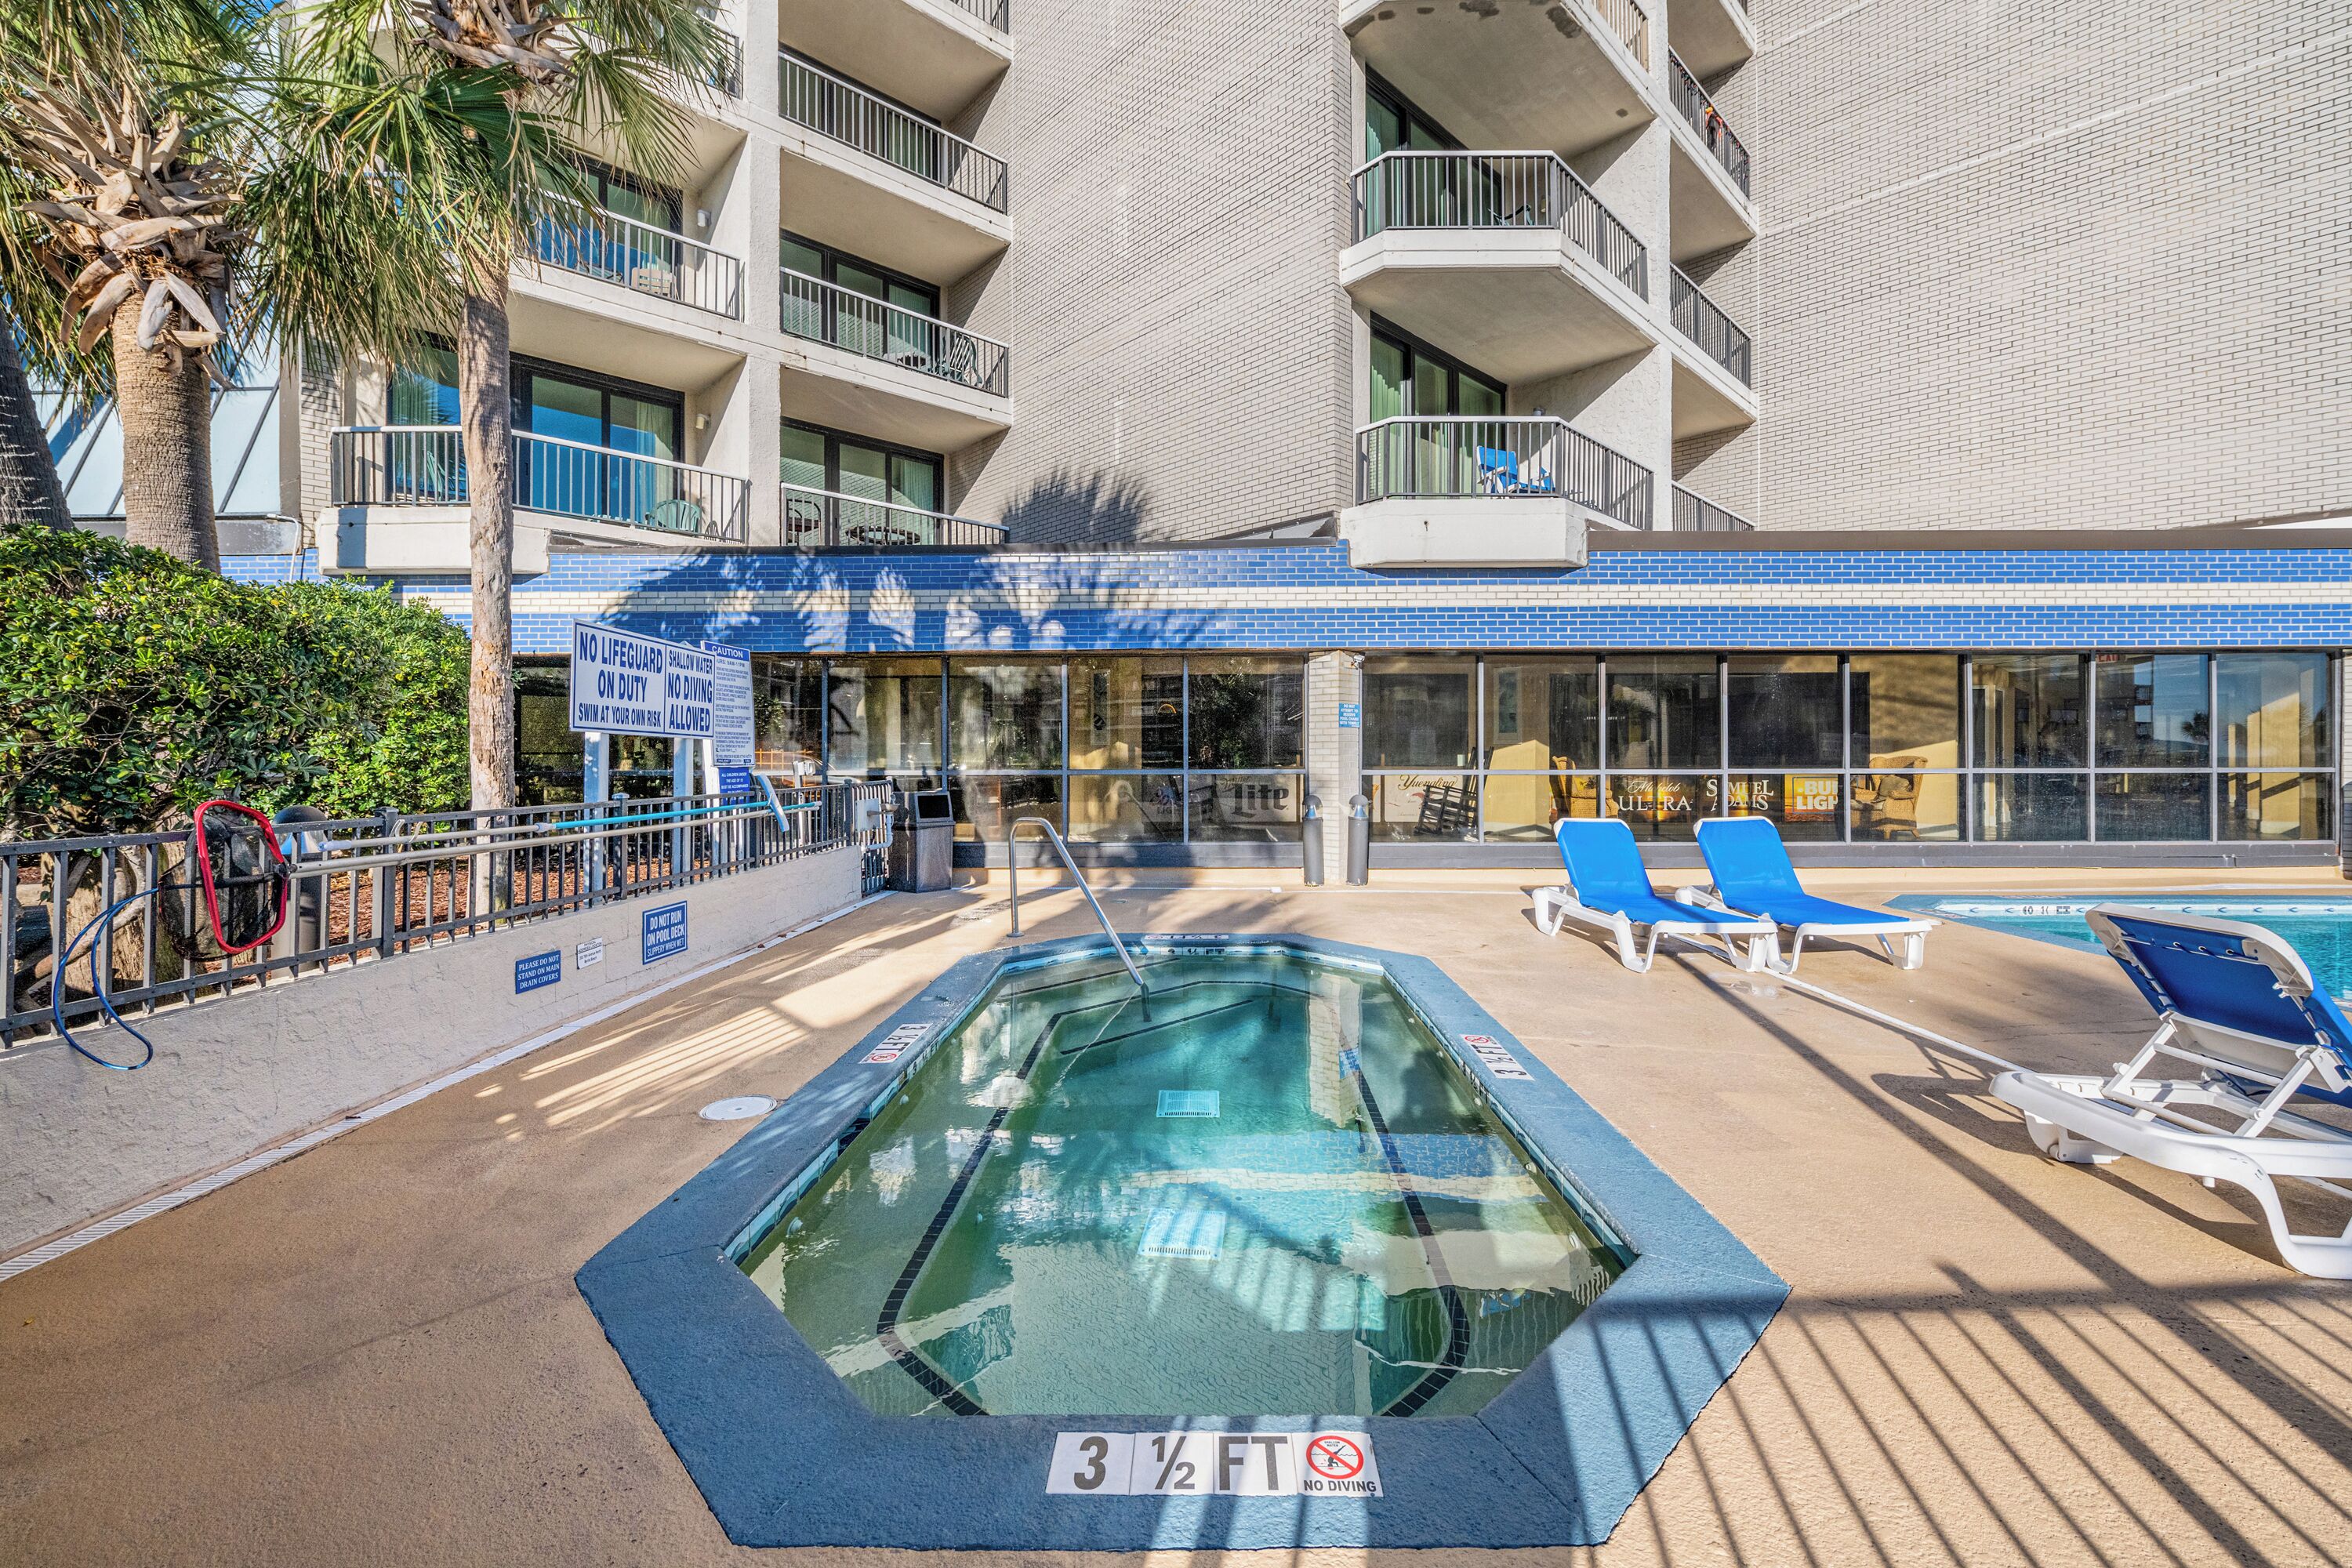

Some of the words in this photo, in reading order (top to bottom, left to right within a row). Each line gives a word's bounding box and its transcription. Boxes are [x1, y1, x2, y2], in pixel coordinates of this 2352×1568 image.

[579, 631, 597, 662] NO
[601, 636, 662, 674] LIFEGUARD
[712, 645, 743, 658] CAUTION
[669, 649, 695, 671] SHALLOW
[696, 655, 713, 674] WATER
[598, 670, 614, 699] ON
[619, 673, 648, 703] DUTY
[668, 672, 681, 699] NO
[684, 675, 713, 703] DIVING
[579, 702, 598, 722] SWIM
[601, 705, 609, 723] AT
[612, 706, 630, 725] YOUR
[631, 708, 645, 726] OWN
[647, 710, 661, 728] RISK
[669, 703, 710, 731] ALLOWED
[1398, 775, 1458, 790] Yuengling
[1628, 780, 1681, 793] Mihelob
[1706, 779, 1774, 797] SMUEL
[1232, 783, 1289, 818] Lite
[1618, 795, 1692, 811] ULTRA
[1796, 796, 1838, 810] LIGH
[650, 916, 658, 930] DO
[659, 913, 670, 927] NOT
[671, 910, 681, 924] RUN
[647, 932, 655, 946] ON
[656, 928, 670, 944] POOL
[671, 924, 684, 939] DECK
[648, 944, 665, 956] SLIPPERY
[666, 940, 676, 950] WHEN
[517, 970, 536, 980] STAND
[546, 963, 560, 972] MAIN
[518, 960, 539, 971] PLEASE
[549, 954, 559, 963] NOT
[520, 978, 537, 989] DRAIN
[539, 972, 558, 983] COVERS
[1073, 1435, 1109, 1490] 3
[1218, 1435, 1288, 1491] FT
[1304, 1479, 1323, 1491] NO
[1327, 1480, 1377, 1492] DIVING
